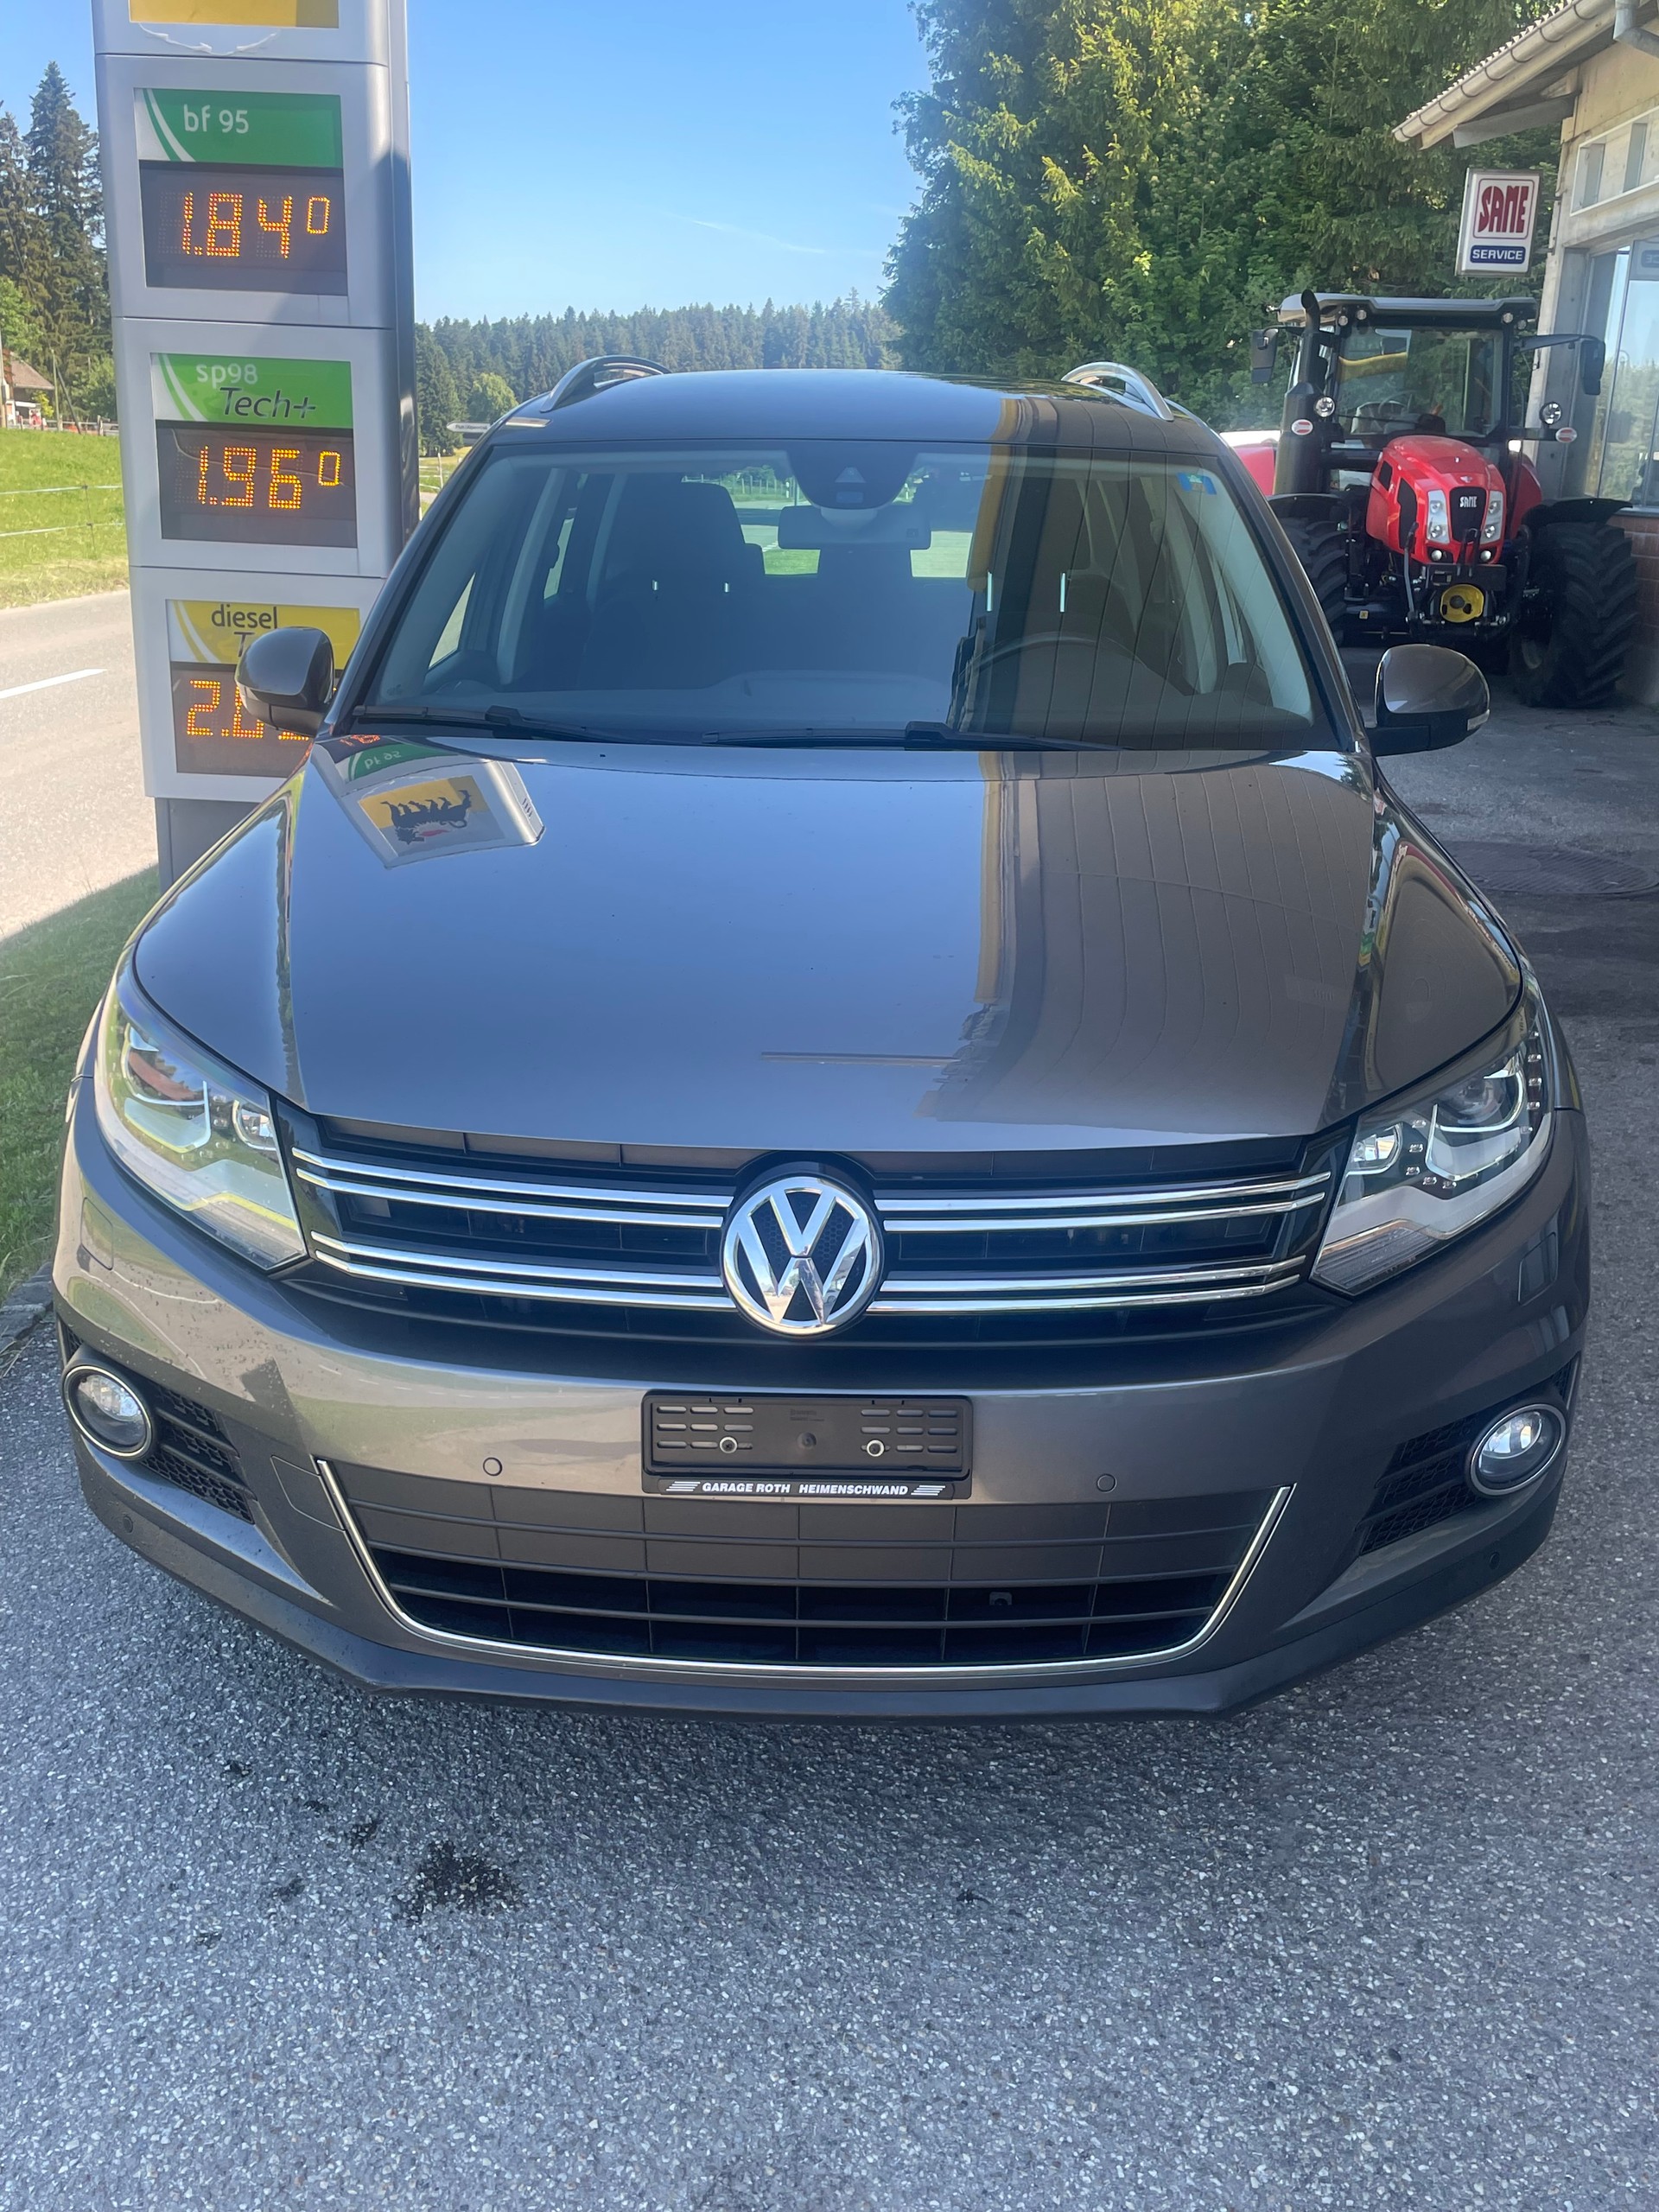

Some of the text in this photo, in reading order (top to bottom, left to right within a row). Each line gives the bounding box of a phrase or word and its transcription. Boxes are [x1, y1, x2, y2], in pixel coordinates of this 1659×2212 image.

[183, 104, 250, 134] bf 95
[1478, 185, 1529, 233] SAME
[1471, 249, 1523, 260] SERVICE
[195, 363, 258, 388] sp98
[219, 386, 317, 419] Tech+
[1459, 496, 1478, 508] SAME
[211, 604, 278, 629] diesel
[702, 1482, 908, 1496] GARAGE ROTH HEIMENSCHWAND
